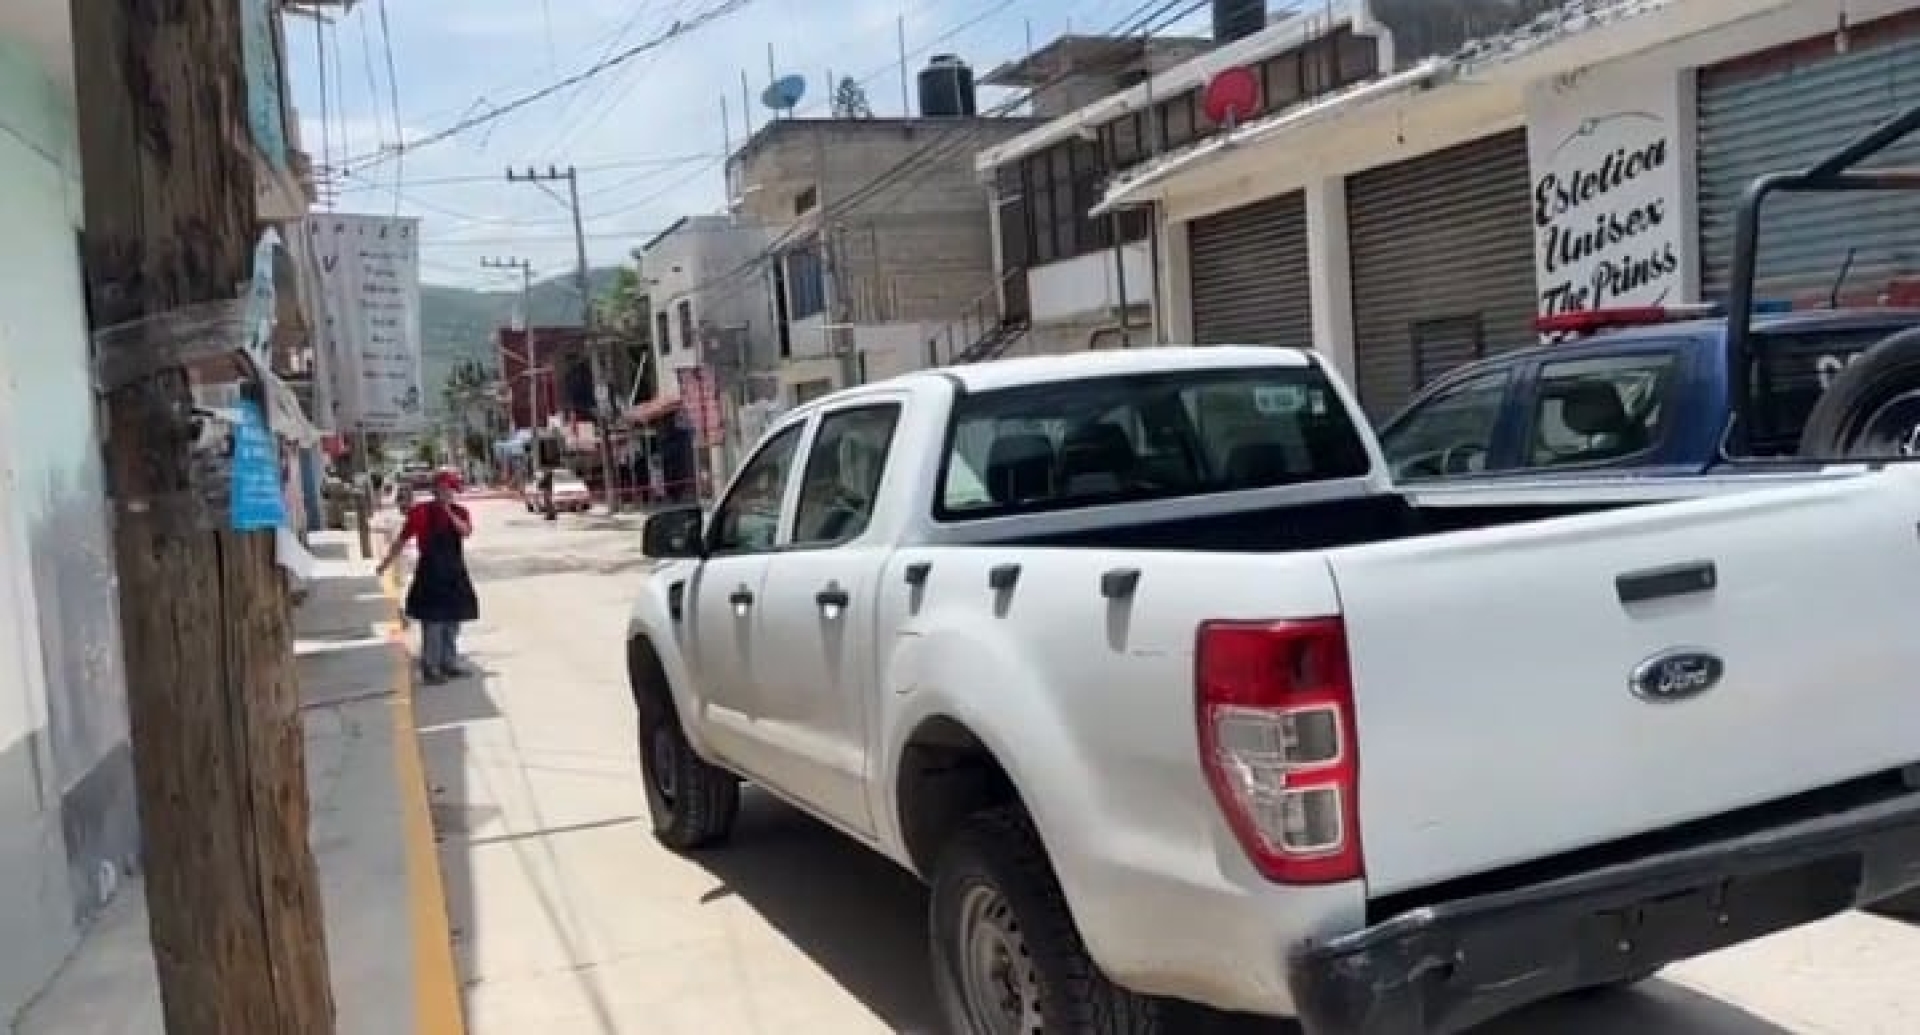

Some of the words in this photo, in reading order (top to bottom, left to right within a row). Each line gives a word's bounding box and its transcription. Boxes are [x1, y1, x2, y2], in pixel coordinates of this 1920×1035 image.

[1543, 197, 1664, 273] Unisex
[1542, 280, 1588, 317] The
[1592, 242, 1677, 310] Prinss
